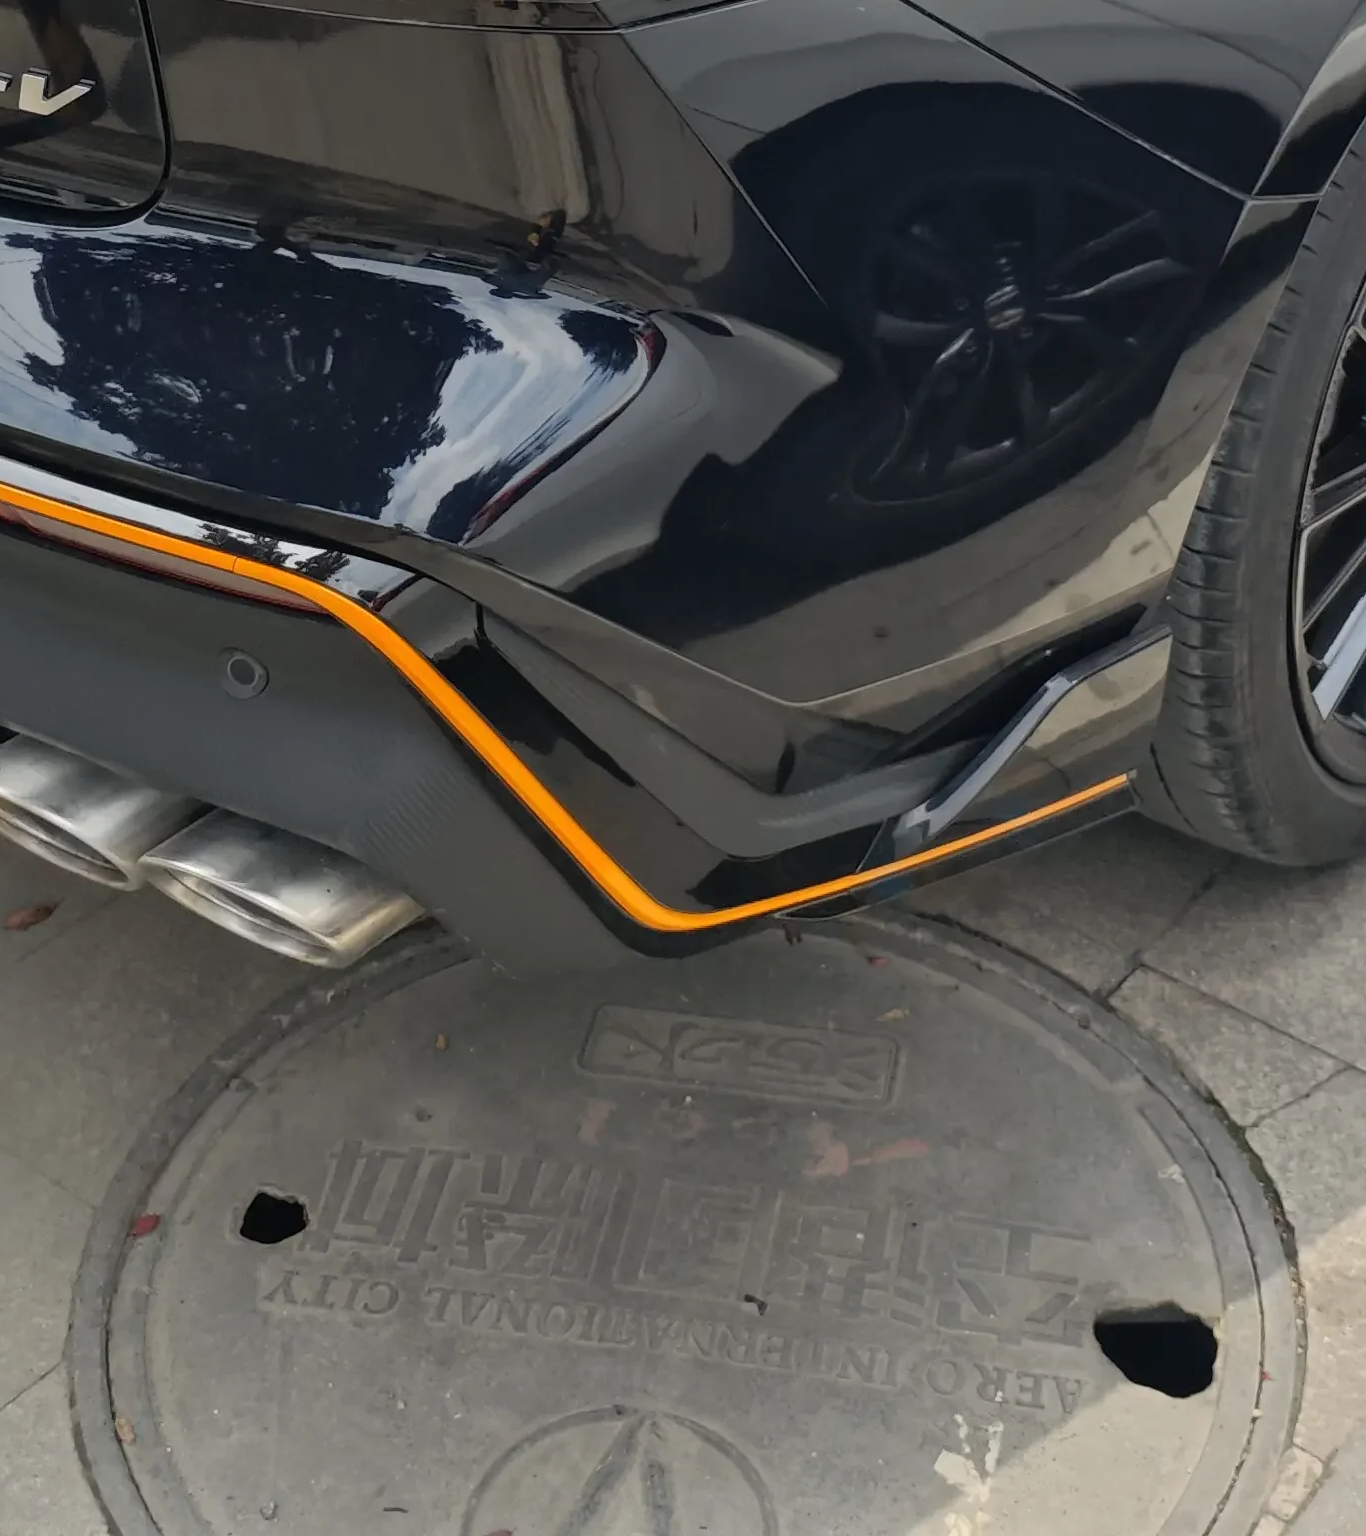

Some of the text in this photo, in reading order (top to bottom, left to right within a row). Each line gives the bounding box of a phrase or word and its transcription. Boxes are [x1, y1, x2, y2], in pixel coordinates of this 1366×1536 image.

[262, 1269, 1088, 1415] AERO INTERNATIONAL CITY
